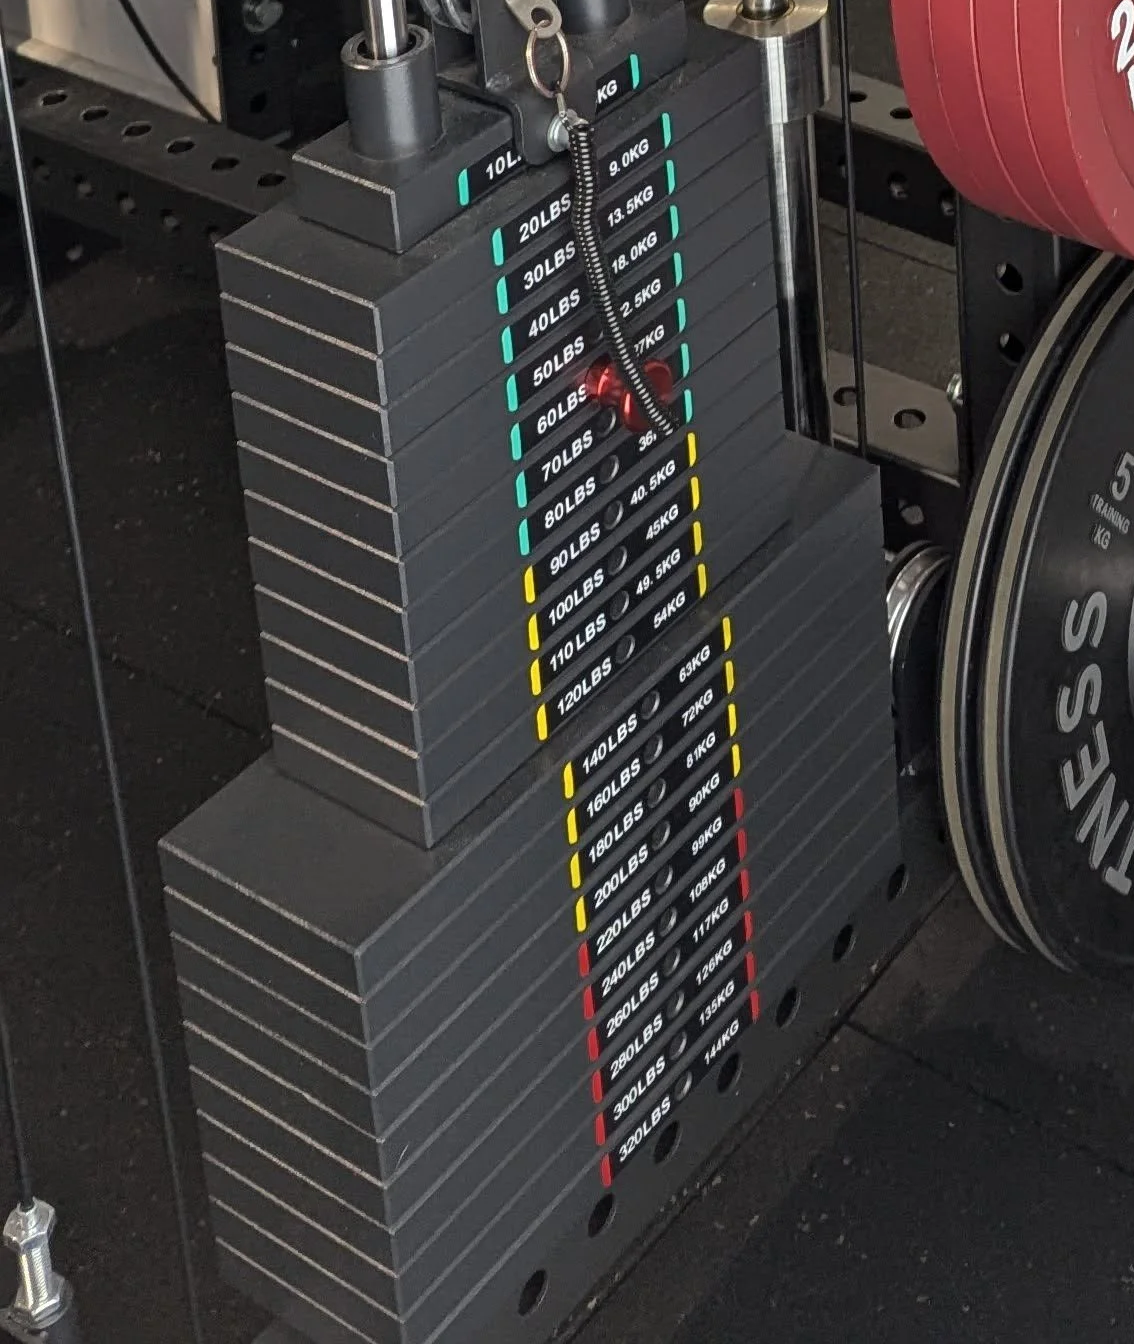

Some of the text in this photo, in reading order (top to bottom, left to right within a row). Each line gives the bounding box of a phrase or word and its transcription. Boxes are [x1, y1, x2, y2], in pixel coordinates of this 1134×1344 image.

[485, 150, 522, 180] 10L
[518, 138, 650, 244] 20LBS 9.0KG
[523, 185, 654, 290] 30LBS 13.5KG
[528, 231, 658, 337] 40LBS 18.0KG
[533, 278, 662, 387] 50LBS 2.5KG
[537, 383, 588, 435] 60LBS
[541, 429, 593, 482] 70LBS
[544, 476, 596, 529] 80LBS
[550, 459, 676, 576] 90LBS 40.5KG
[1091, 493, 1131, 534] TRAINING
[1093, 524, 1111, 550] KG
[548, 503, 679, 626] 100LBS 45KG
[549, 548, 681, 672] 110LBS 49.5KG
[557, 591, 686, 716] 120LBS 54KG
[582, 644, 711, 774] 140LBS 63KG
[586, 688, 714, 818] 160LBS 72KG
[588, 731, 716, 863] 180LBS 81KG
[594, 772, 720, 909] 200LBS 90KG
[596, 816, 723, 955] 220LBS 99KG
[601, 857, 726, 997] 240LBS 108KG
[606, 897, 729, 1038] 260LBS 117KG
[610, 939, 733, 1081] 280LBS 126KG
[613, 980, 735, 1121] 300LBS 135KG
[618, 1019, 740, 1162] 320LBS 144KG
